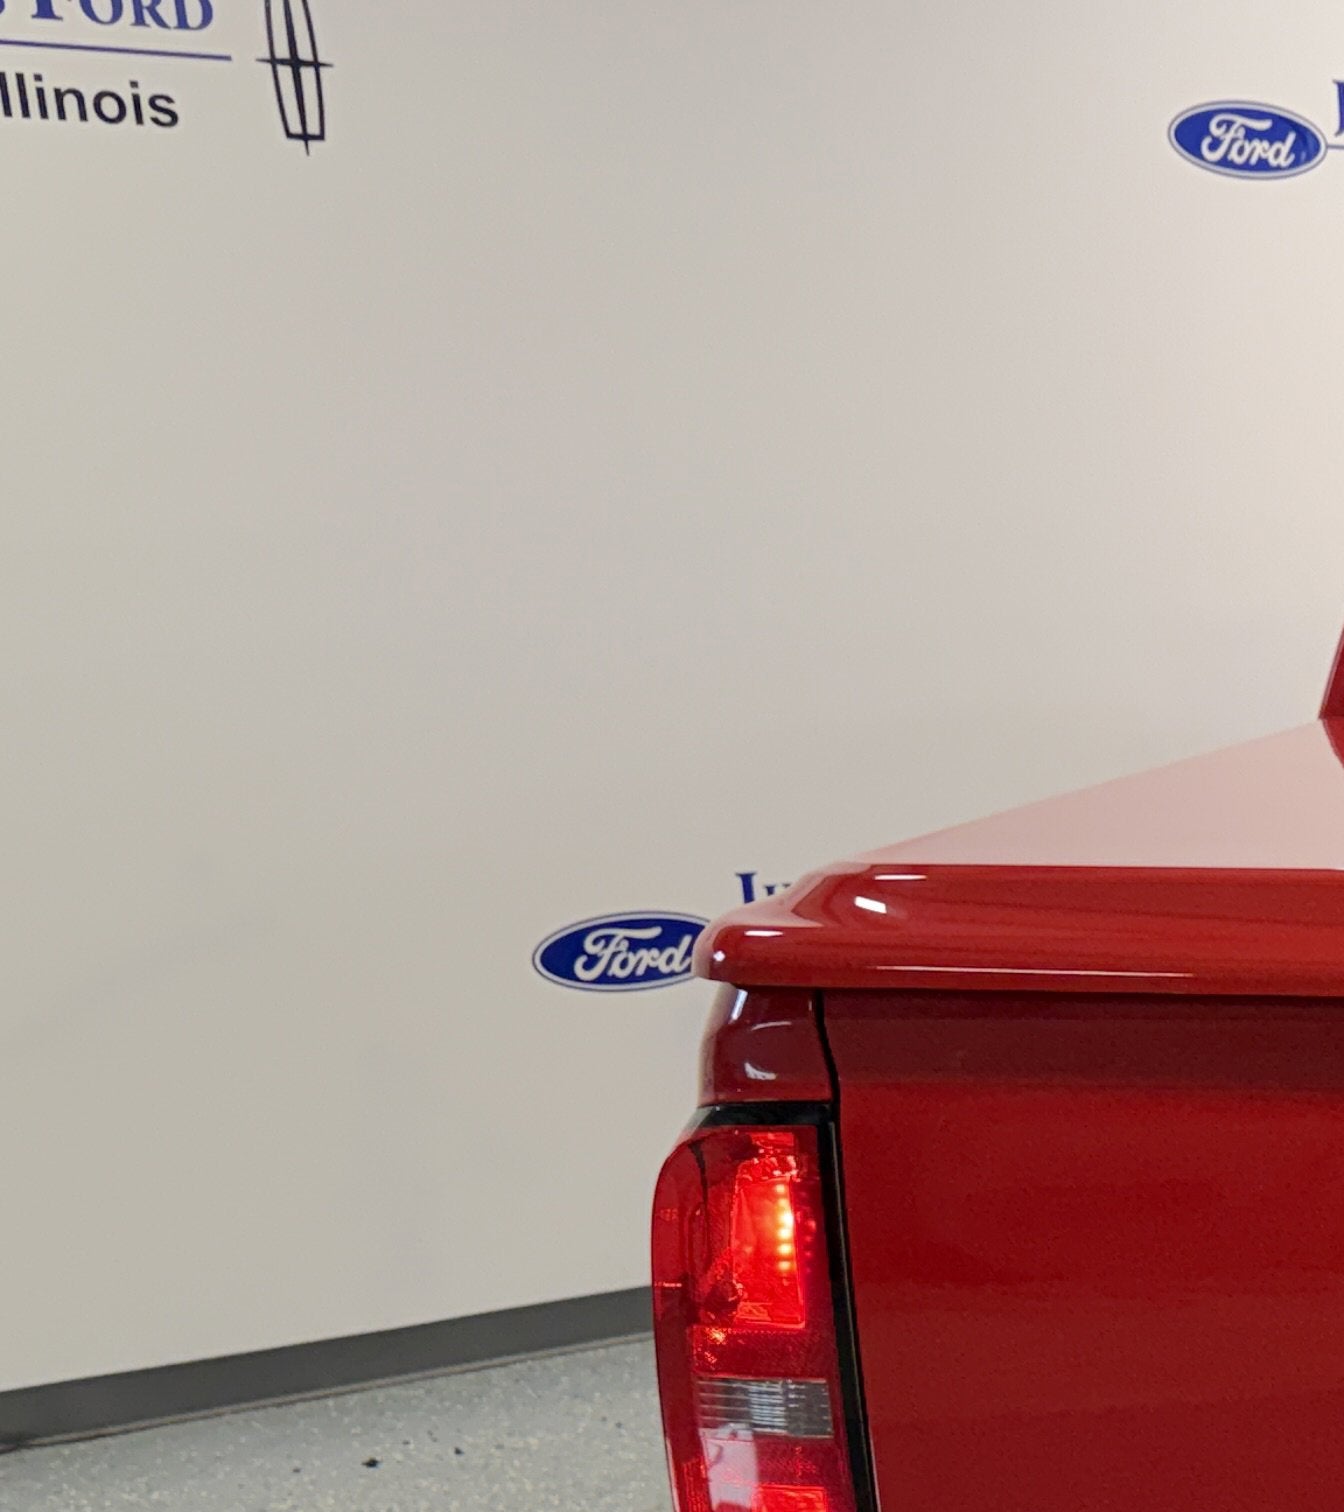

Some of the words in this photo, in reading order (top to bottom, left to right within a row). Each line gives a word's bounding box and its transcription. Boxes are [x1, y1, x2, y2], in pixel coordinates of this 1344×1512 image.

[0, 71, 179, 129] llinois
[1200, 112, 1296, 168] Ford
[573, 925, 693, 981] Ford
